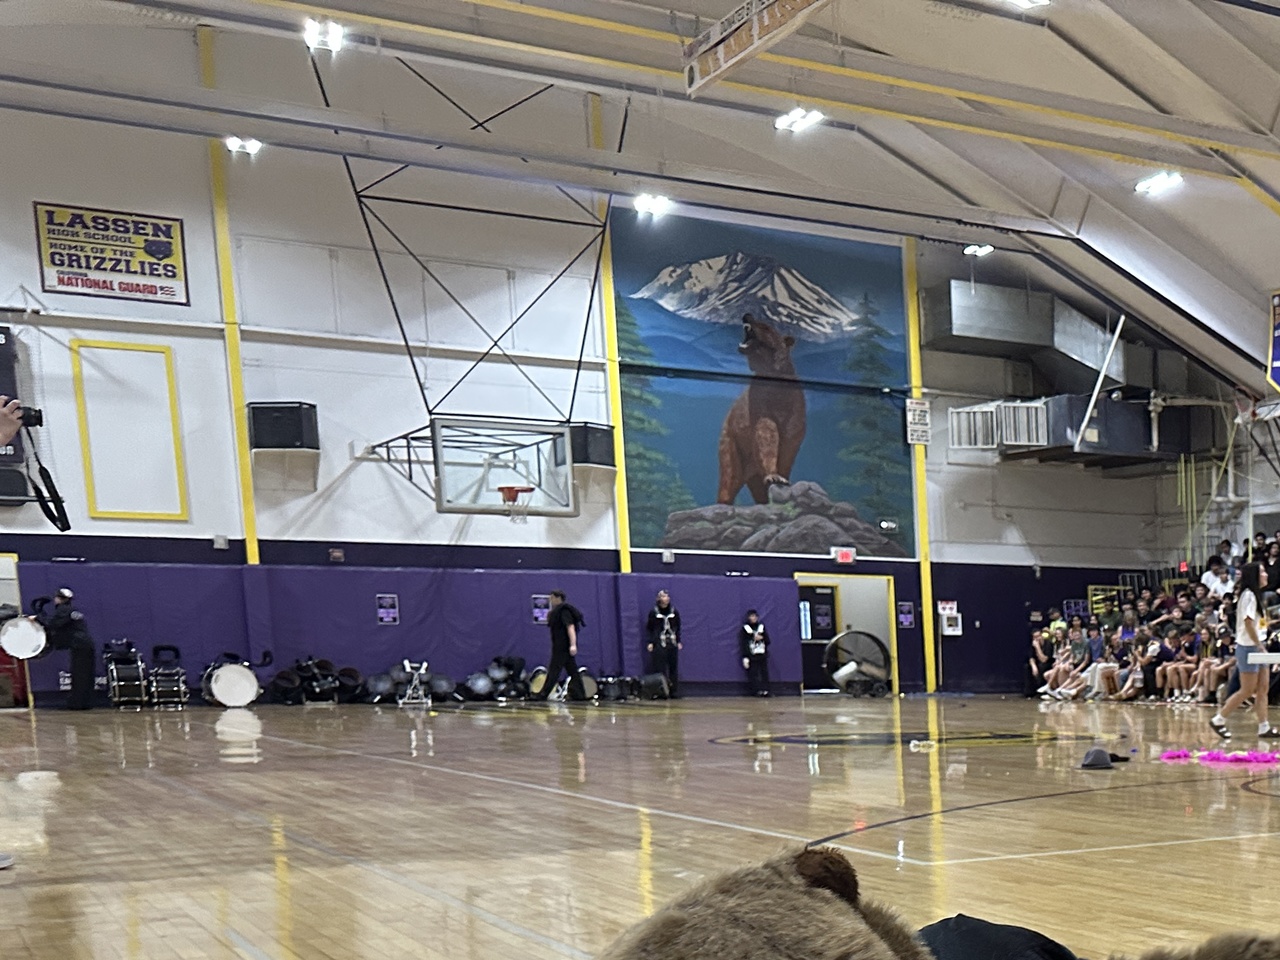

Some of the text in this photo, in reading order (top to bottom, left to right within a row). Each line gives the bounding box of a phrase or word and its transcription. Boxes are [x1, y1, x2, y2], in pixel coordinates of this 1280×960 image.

[45, 210, 174, 239] LASSEN
[47, 228, 135, 244] HIGH SCHOOL
[50, 243, 136, 258] HOME OF THE
[50, 252, 177, 279] GRIZZLIES
[57, 276, 158, 295] NATIONAL GUARD
